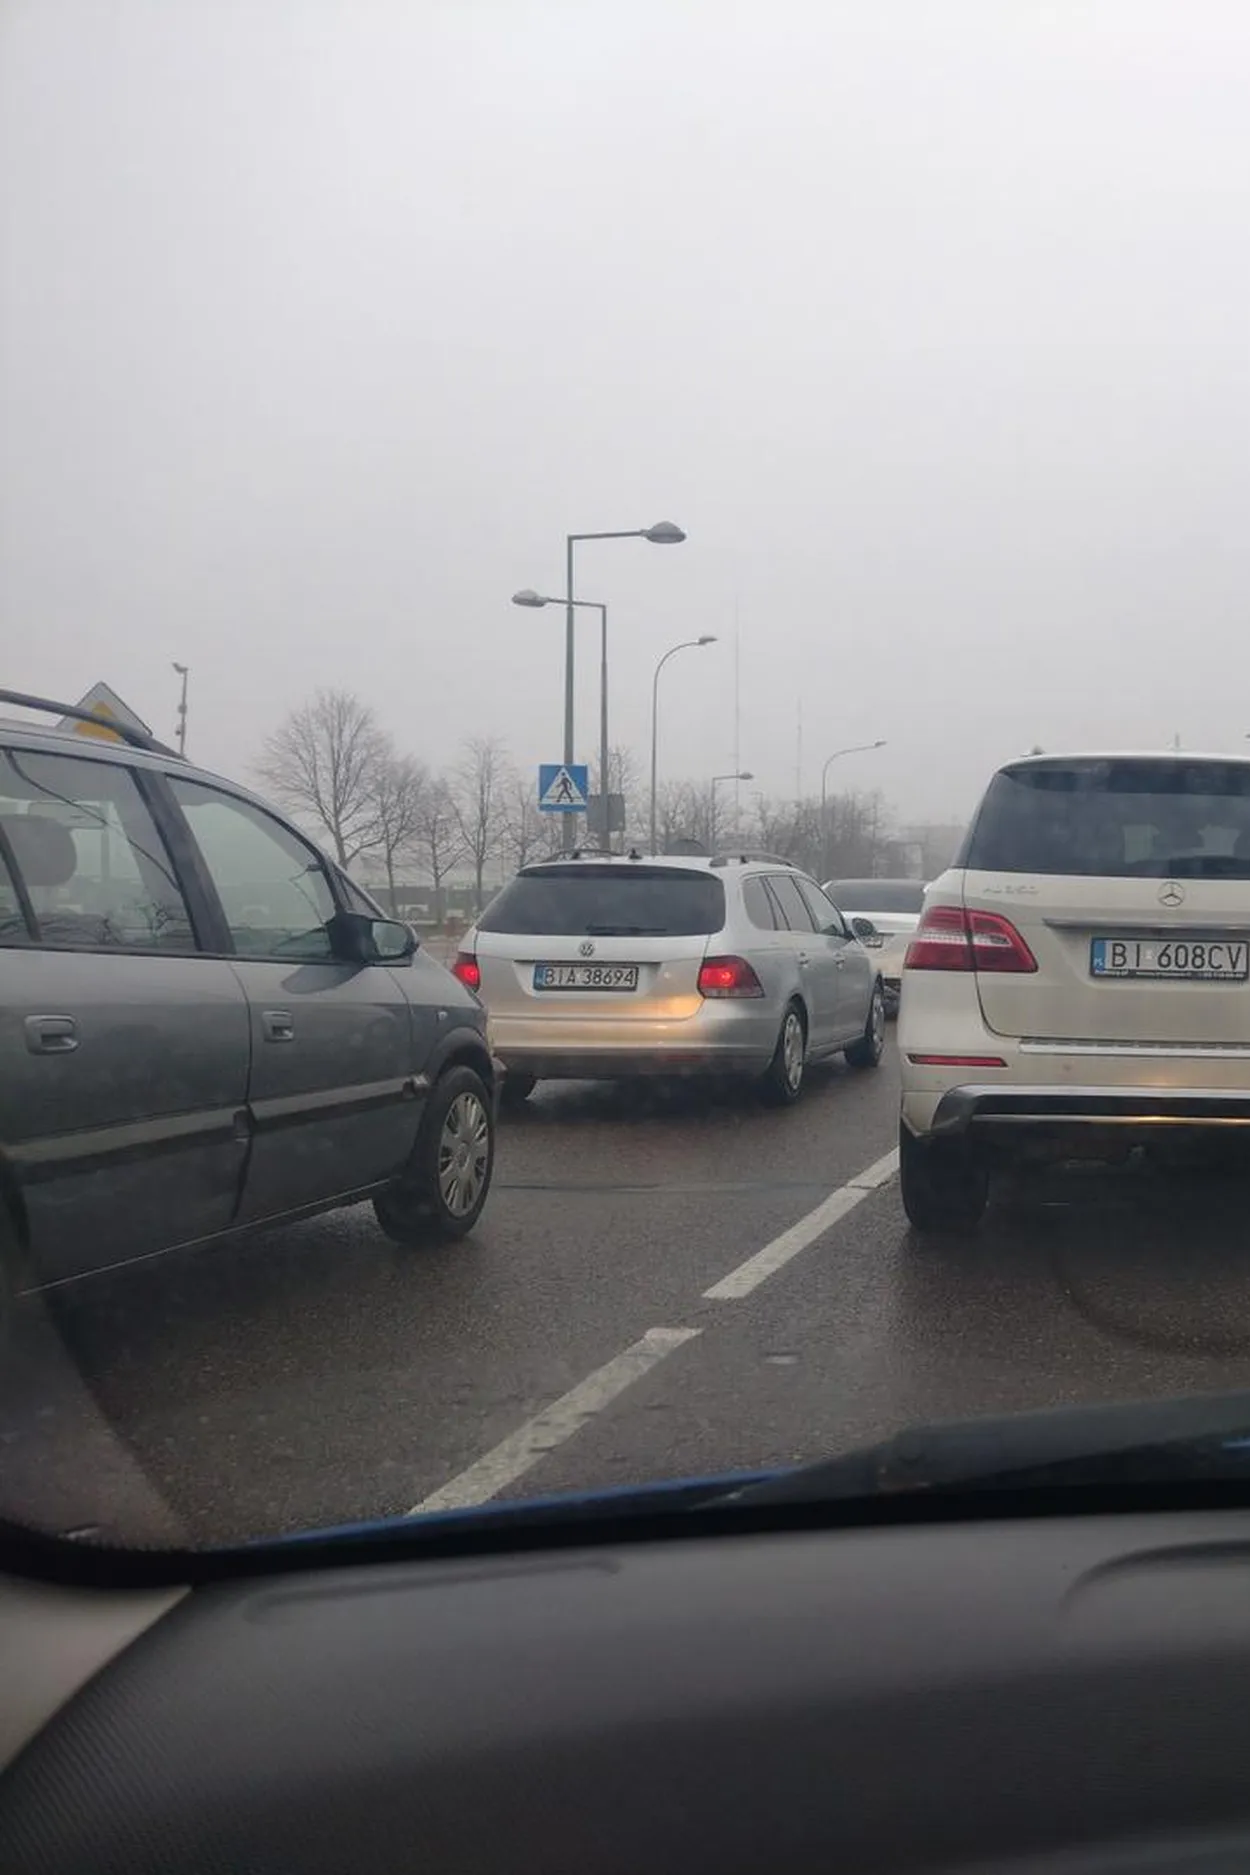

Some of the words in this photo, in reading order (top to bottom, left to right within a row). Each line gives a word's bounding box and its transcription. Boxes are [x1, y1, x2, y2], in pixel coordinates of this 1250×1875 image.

[1111, 943, 1141, 968] BI
[1157, 943, 1242, 970] 608CV
[545, 968, 576, 985] BIA
[582, 968, 634, 985] 38694
